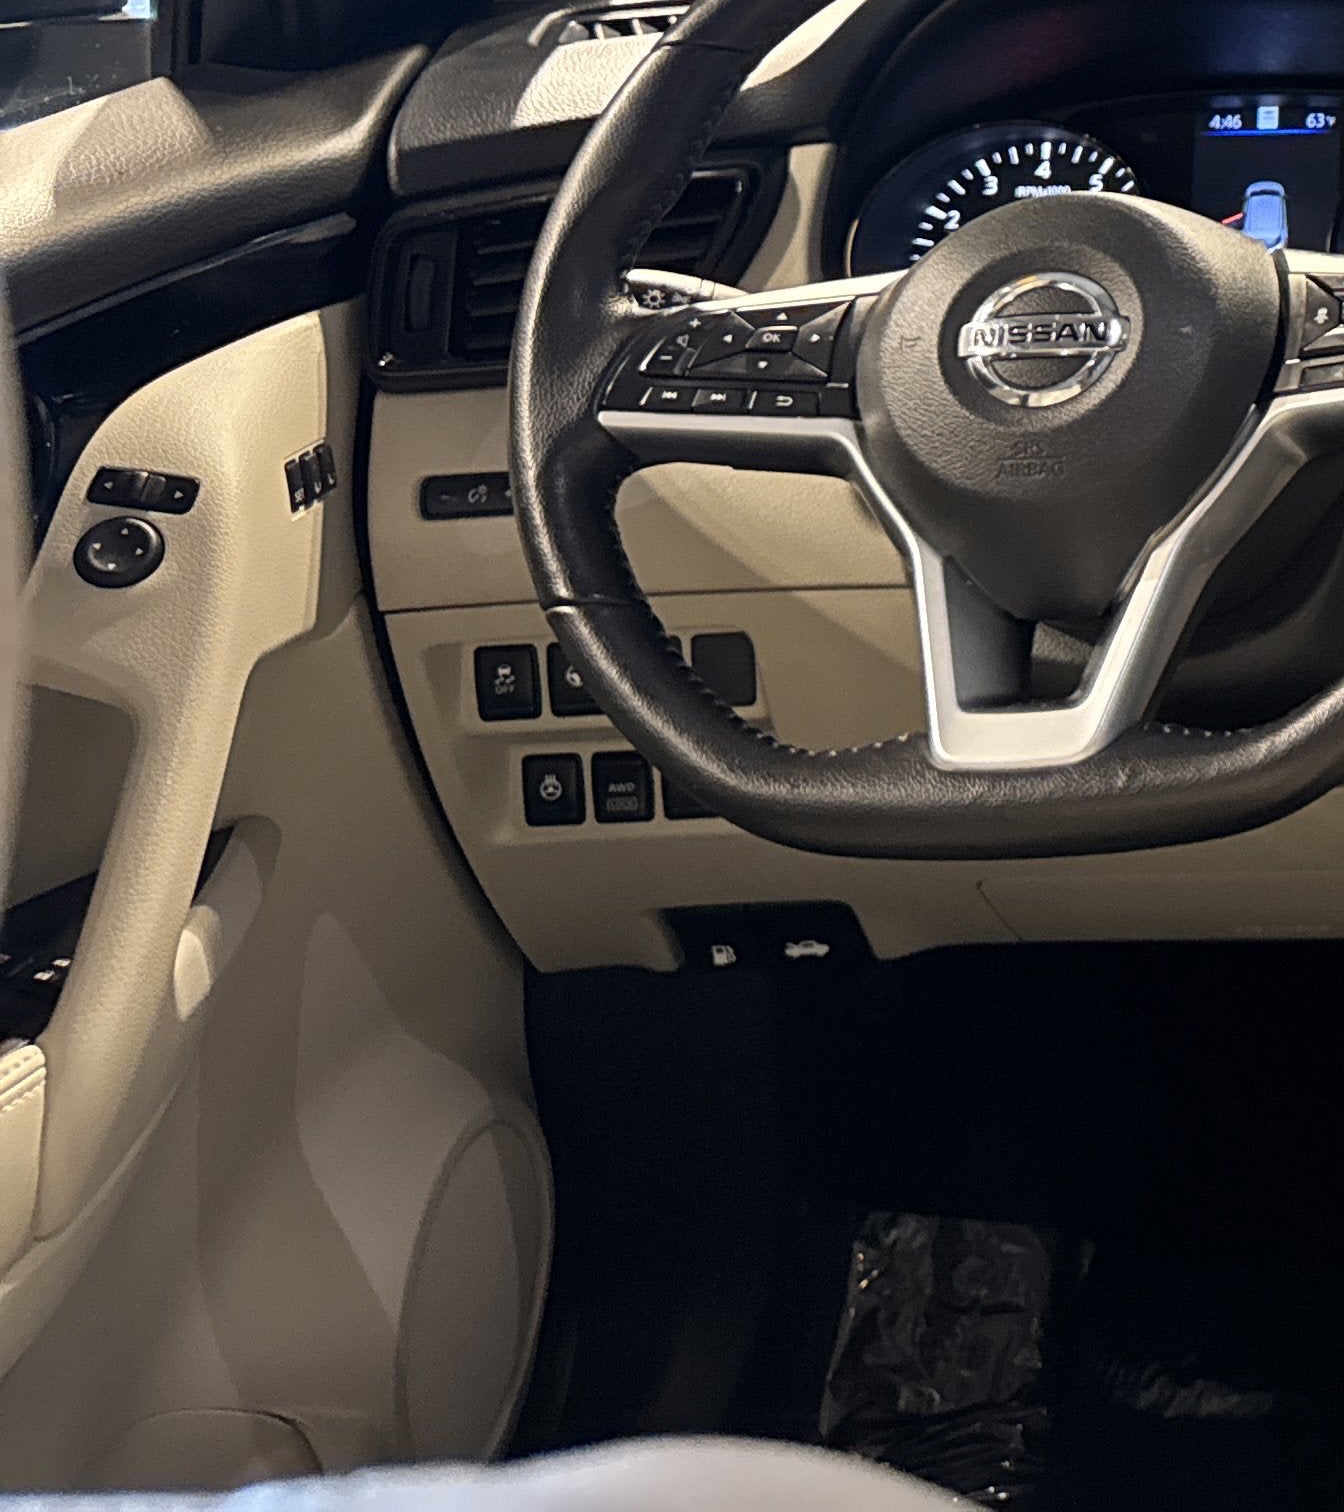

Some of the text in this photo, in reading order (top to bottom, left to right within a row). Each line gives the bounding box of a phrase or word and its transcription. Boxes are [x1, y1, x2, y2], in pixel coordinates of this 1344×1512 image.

[1208, 113, 1243, 130] 4:46
[1034, 159, 1052, 180] 4
[981, 175, 999, 196] 3
[1088, 173, 1104, 193] 5
[943, 210, 961, 230] 2
[762, 332, 782, 343] OK
[972, 322, 1109, 346] NISSAN
